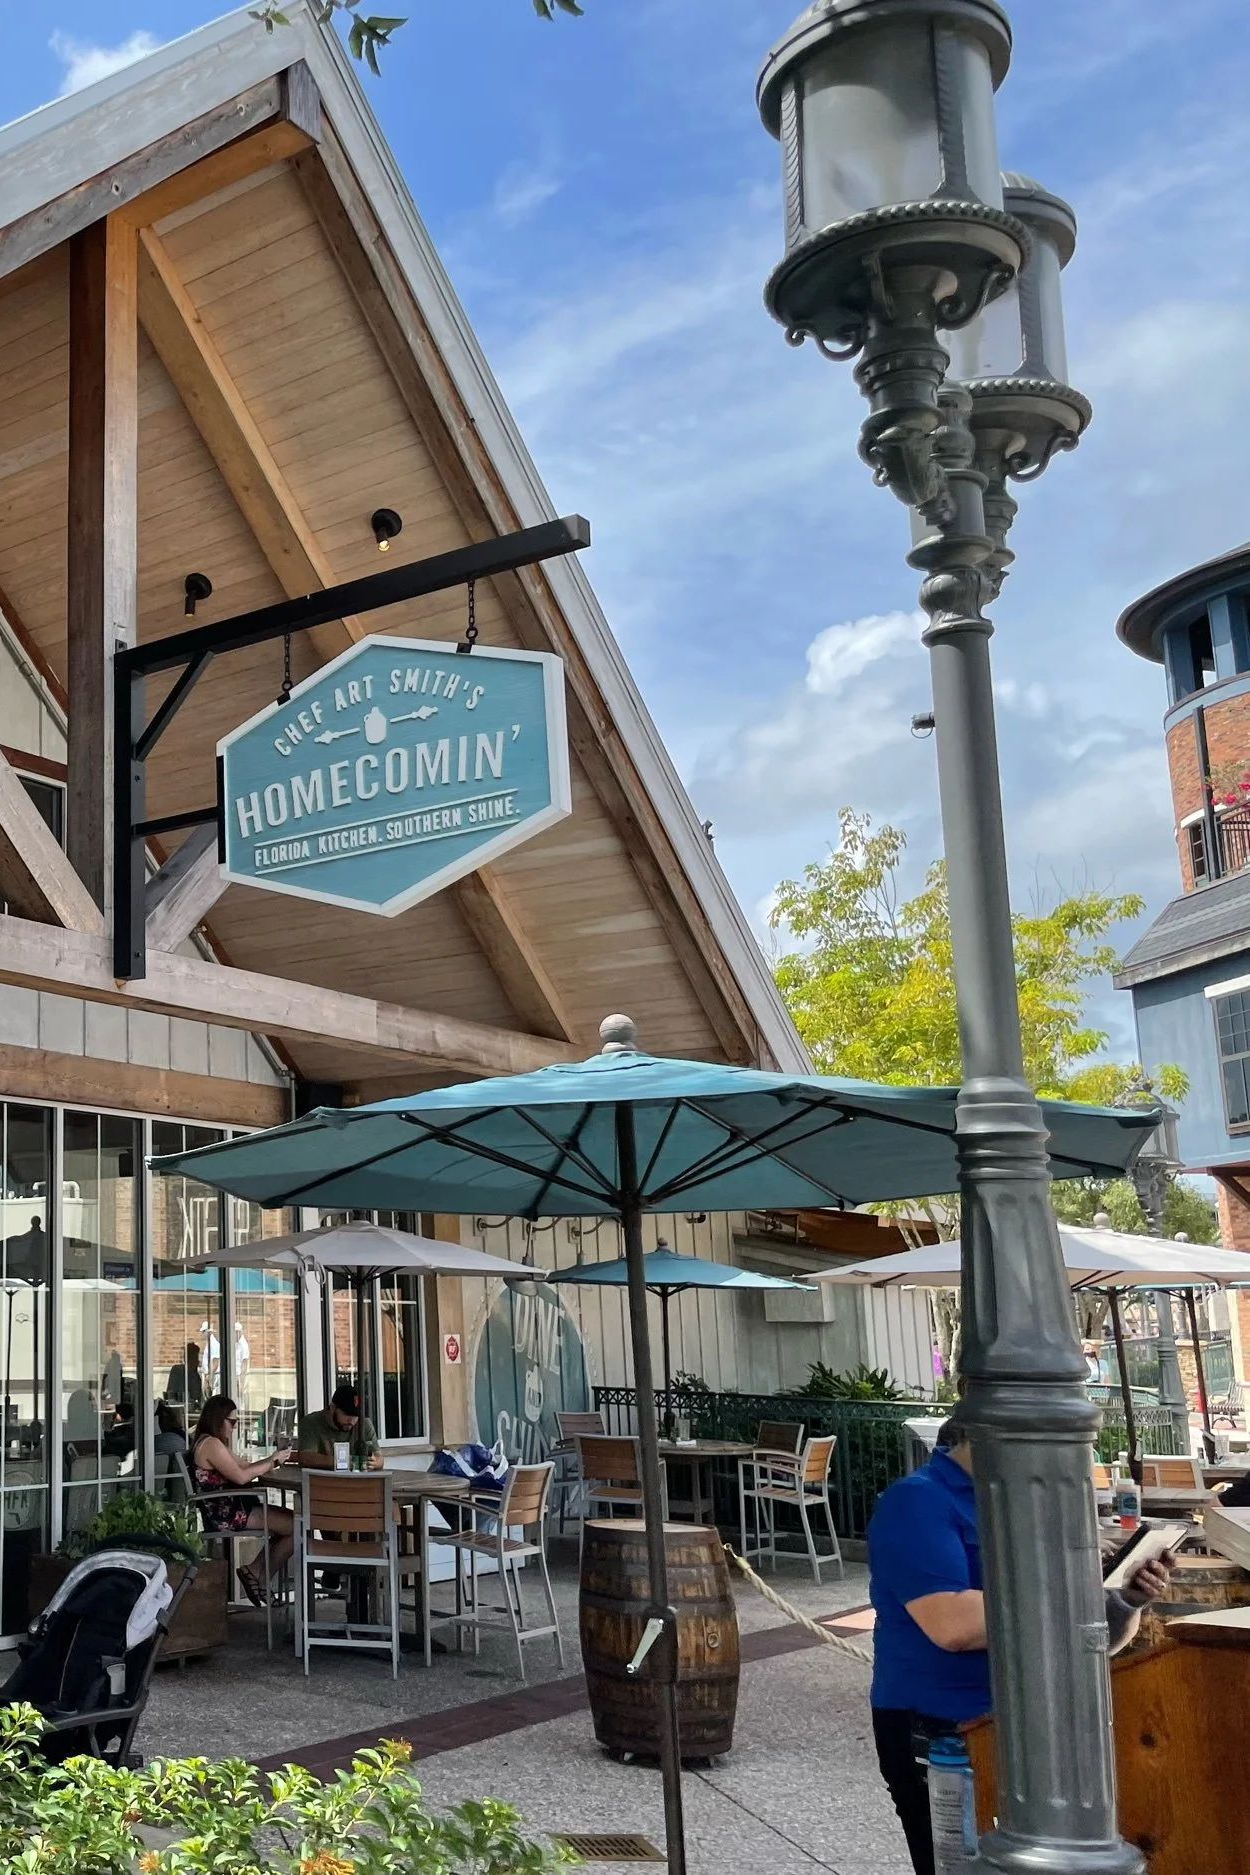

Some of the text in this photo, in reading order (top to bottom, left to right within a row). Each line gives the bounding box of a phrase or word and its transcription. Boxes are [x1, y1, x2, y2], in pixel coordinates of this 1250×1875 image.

[274, 668, 485, 756] CHEF ART SMITH'S
[254, 795, 521, 867] FLORIDA KITCHEN. SOUTHERN SHINE.
[514, 1292, 565, 1376] DINE
